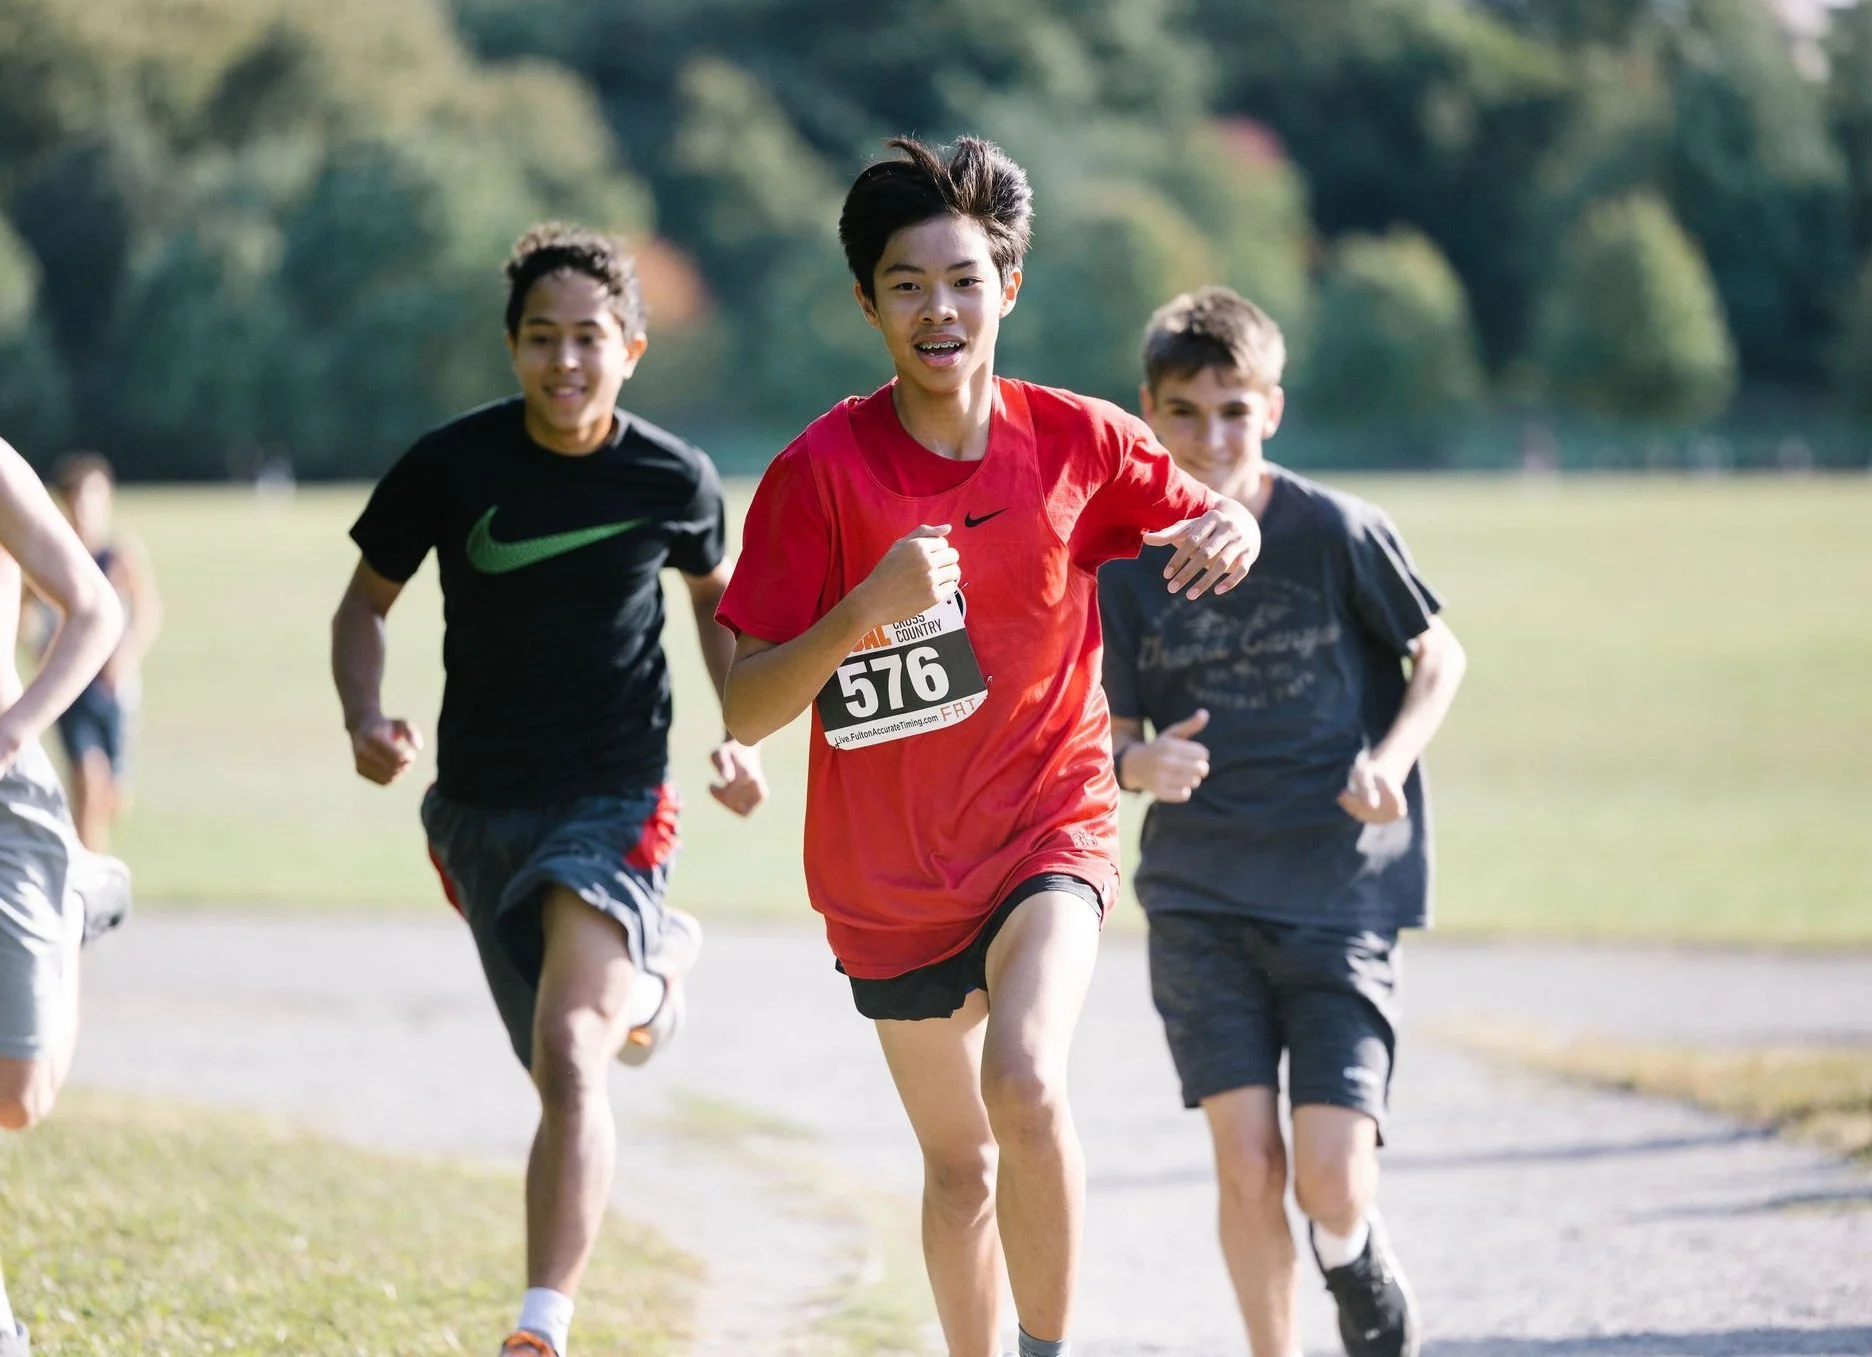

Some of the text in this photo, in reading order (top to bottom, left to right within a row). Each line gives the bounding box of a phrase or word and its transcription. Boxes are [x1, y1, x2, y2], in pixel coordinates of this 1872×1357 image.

[895, 619, 942, 643] COUNTRY
[836, 646, 950, 718] 576
[940, 697, 975, 722] FAT
[835, 714, 938, 745] Live.FultonAccurateTiming.com
